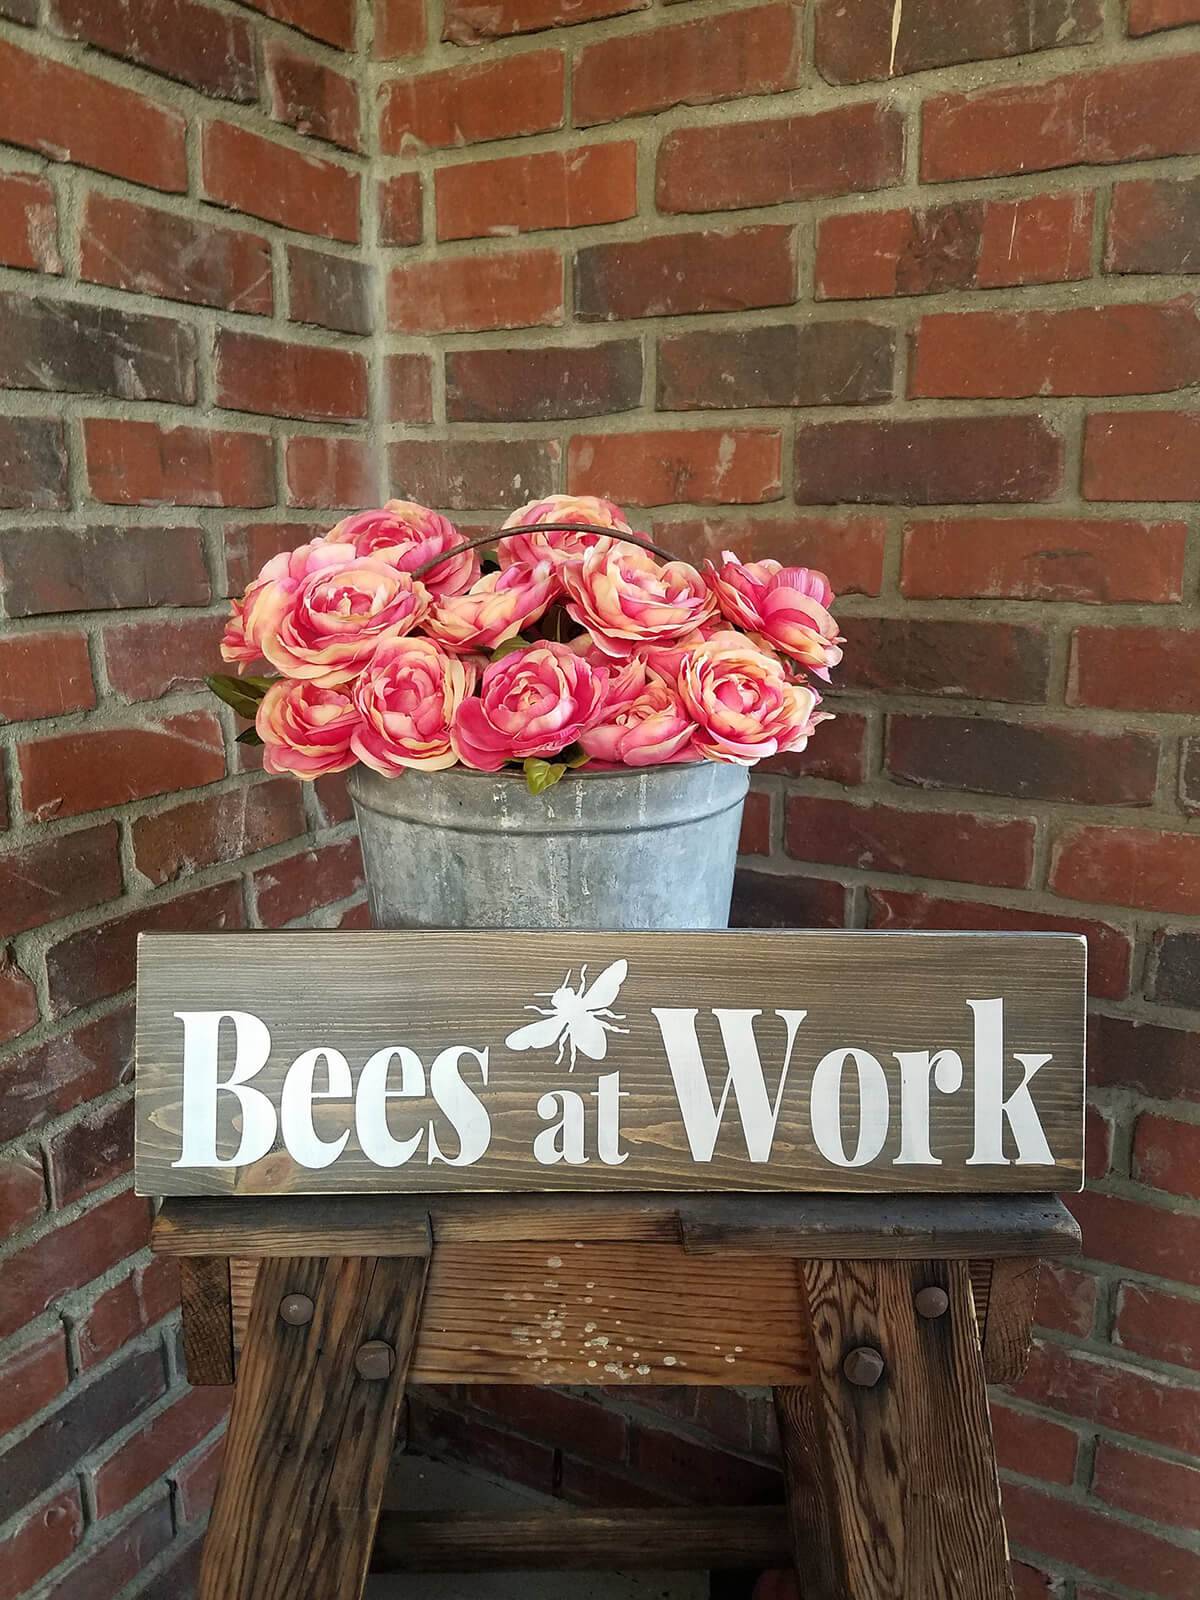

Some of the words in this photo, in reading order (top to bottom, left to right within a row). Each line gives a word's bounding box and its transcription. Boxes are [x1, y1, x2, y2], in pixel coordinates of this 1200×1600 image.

[171, 1009, 492, 1169] Bees
[533, 1071, 630, 1166] at
[651, 997, 1056, 1168] Work
